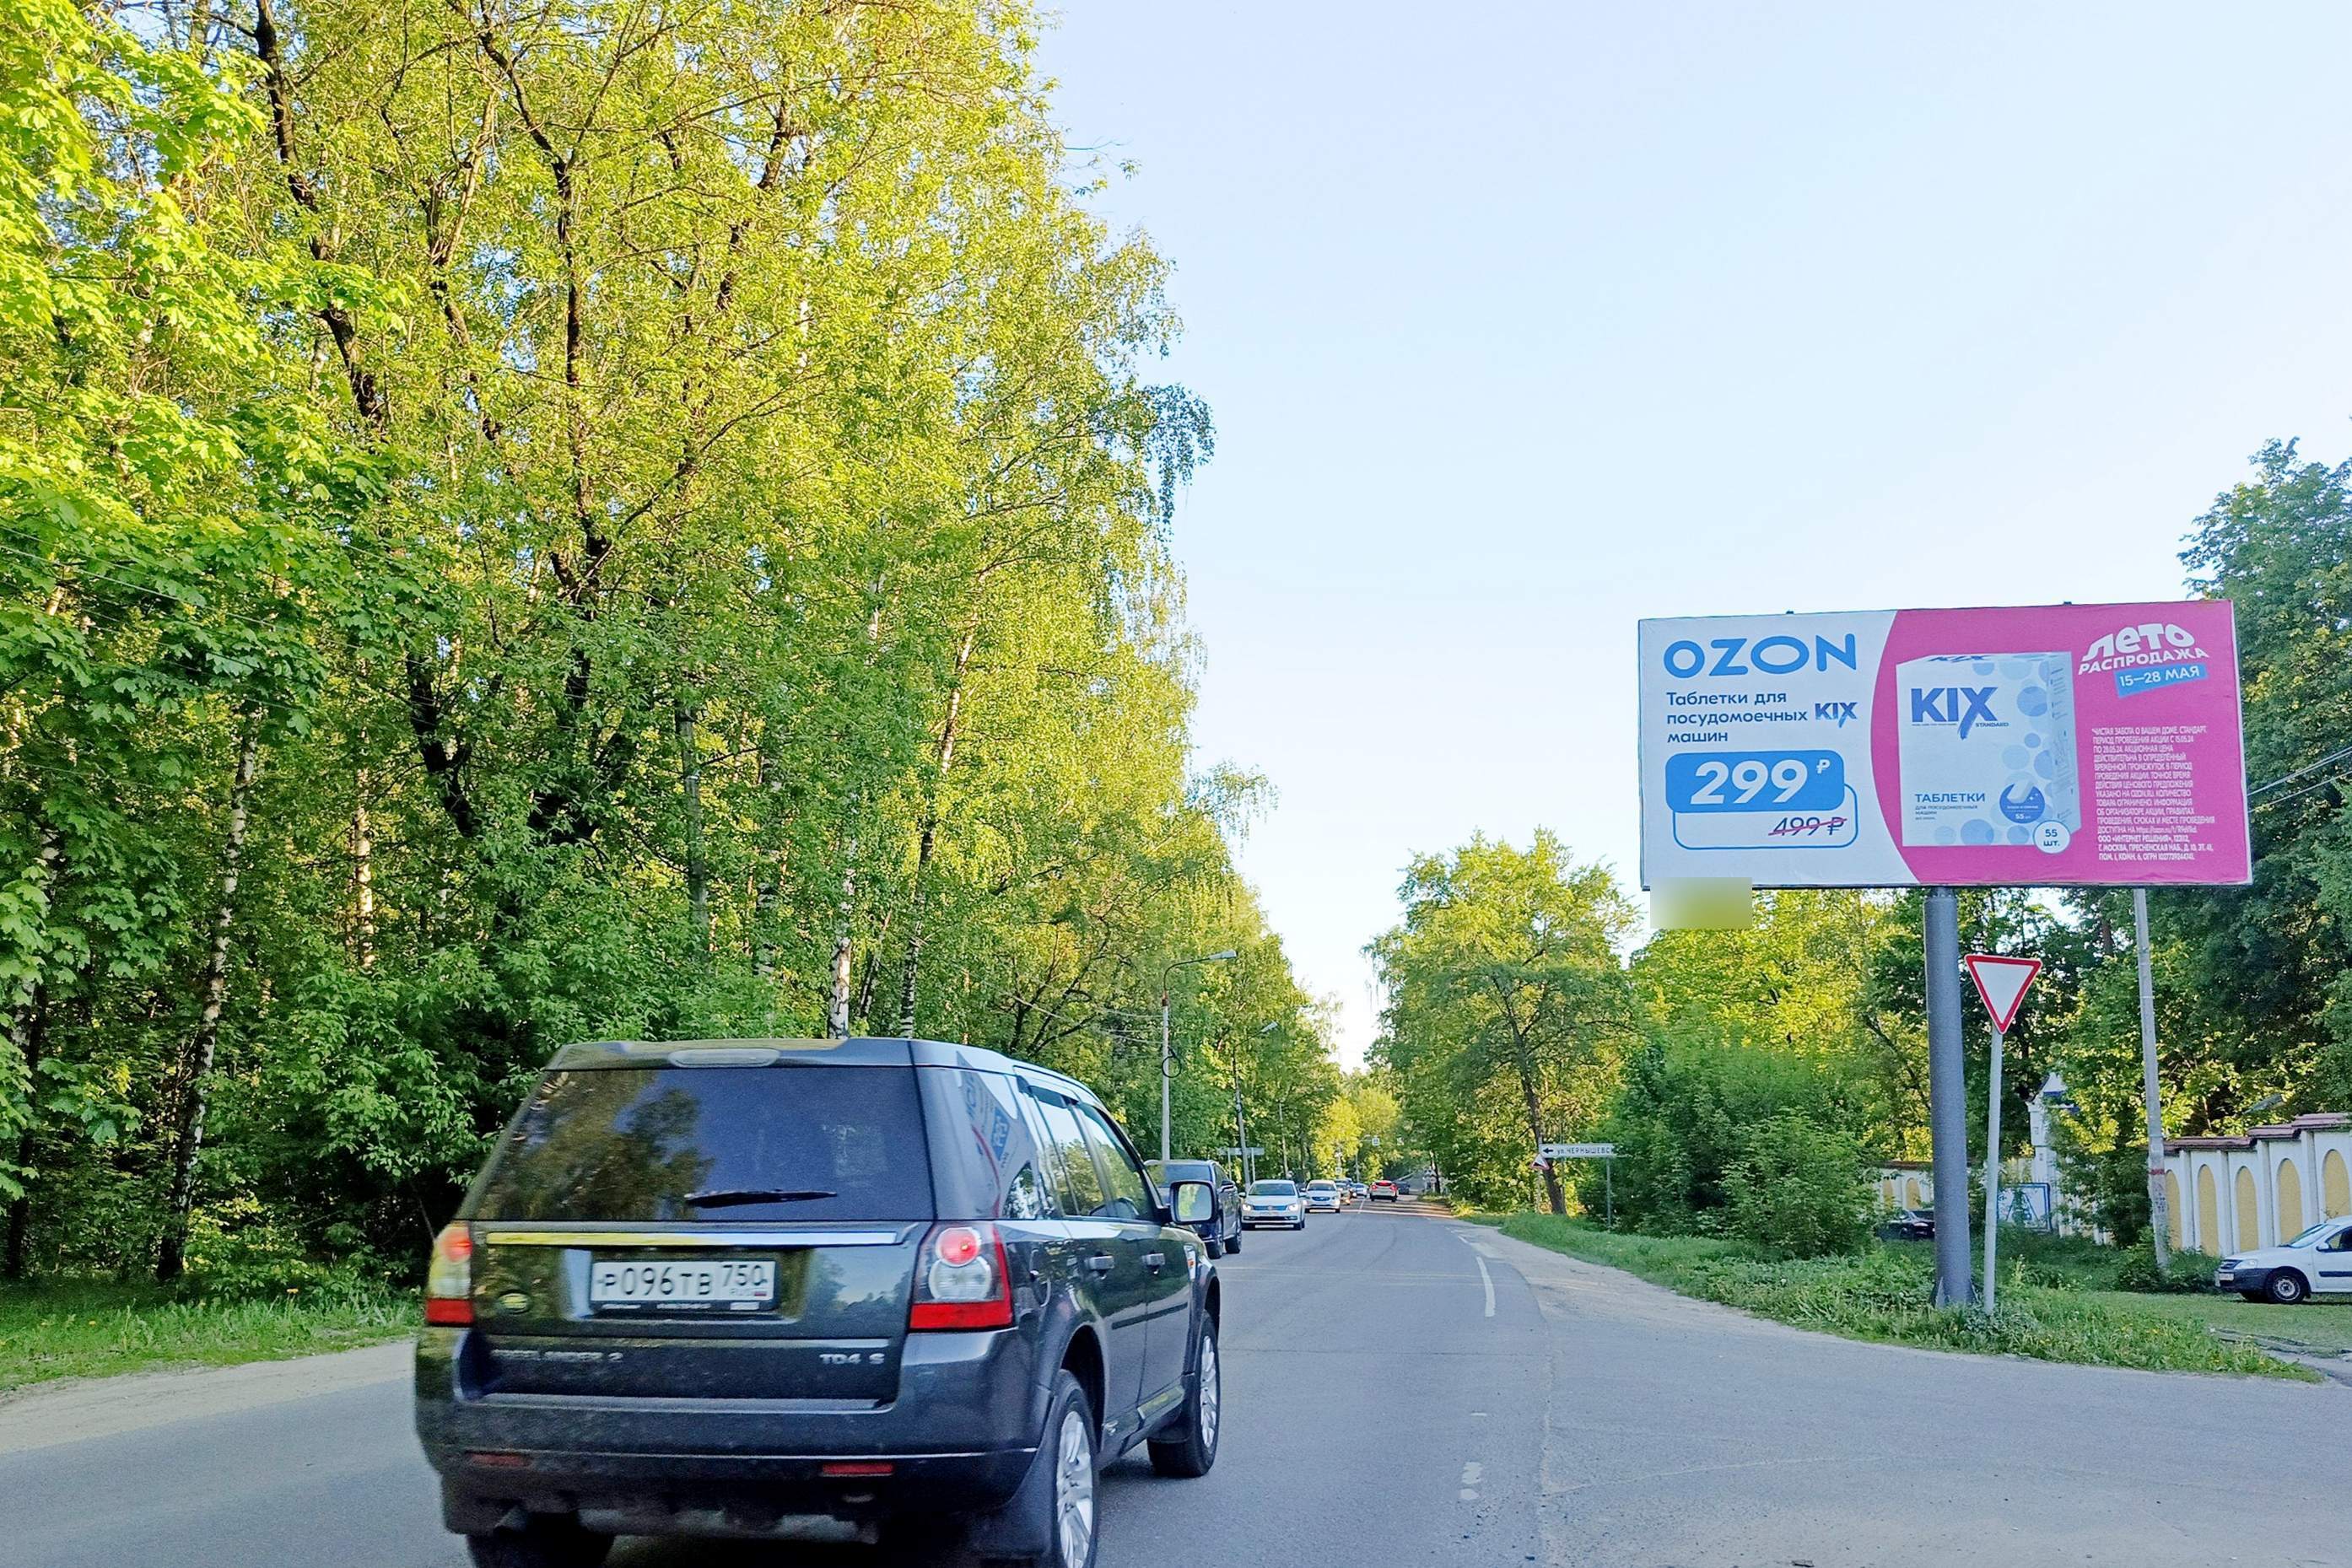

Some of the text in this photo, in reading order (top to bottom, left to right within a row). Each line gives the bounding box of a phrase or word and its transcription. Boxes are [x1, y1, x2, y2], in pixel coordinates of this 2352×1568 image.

[1664, 633, 1857, 678] OZON
[2079, 648, 2209, 675] РАСПРОДАЖА
[2166, 665, 2200, 681] МАЯ
[1667, 691, 1787, 707] Таблетки для
[1667, 709, 1807, 727] посудомоечных
[1815, 702, 1858, 728] KIX
[1911, 687, 1998, 741] KIX
[1667, 732, 1729, 743] машин
[1691, 759, 1808, 805] 299
[1915, 793, 1985, 802] ТАБЛЕТКИ
[1772, 816, 1821, 836] 499
[2045, 829, 2058, 838] 55
[723, 1264, 763, 1286] 750
[869, 1353, 885, 1364] S
